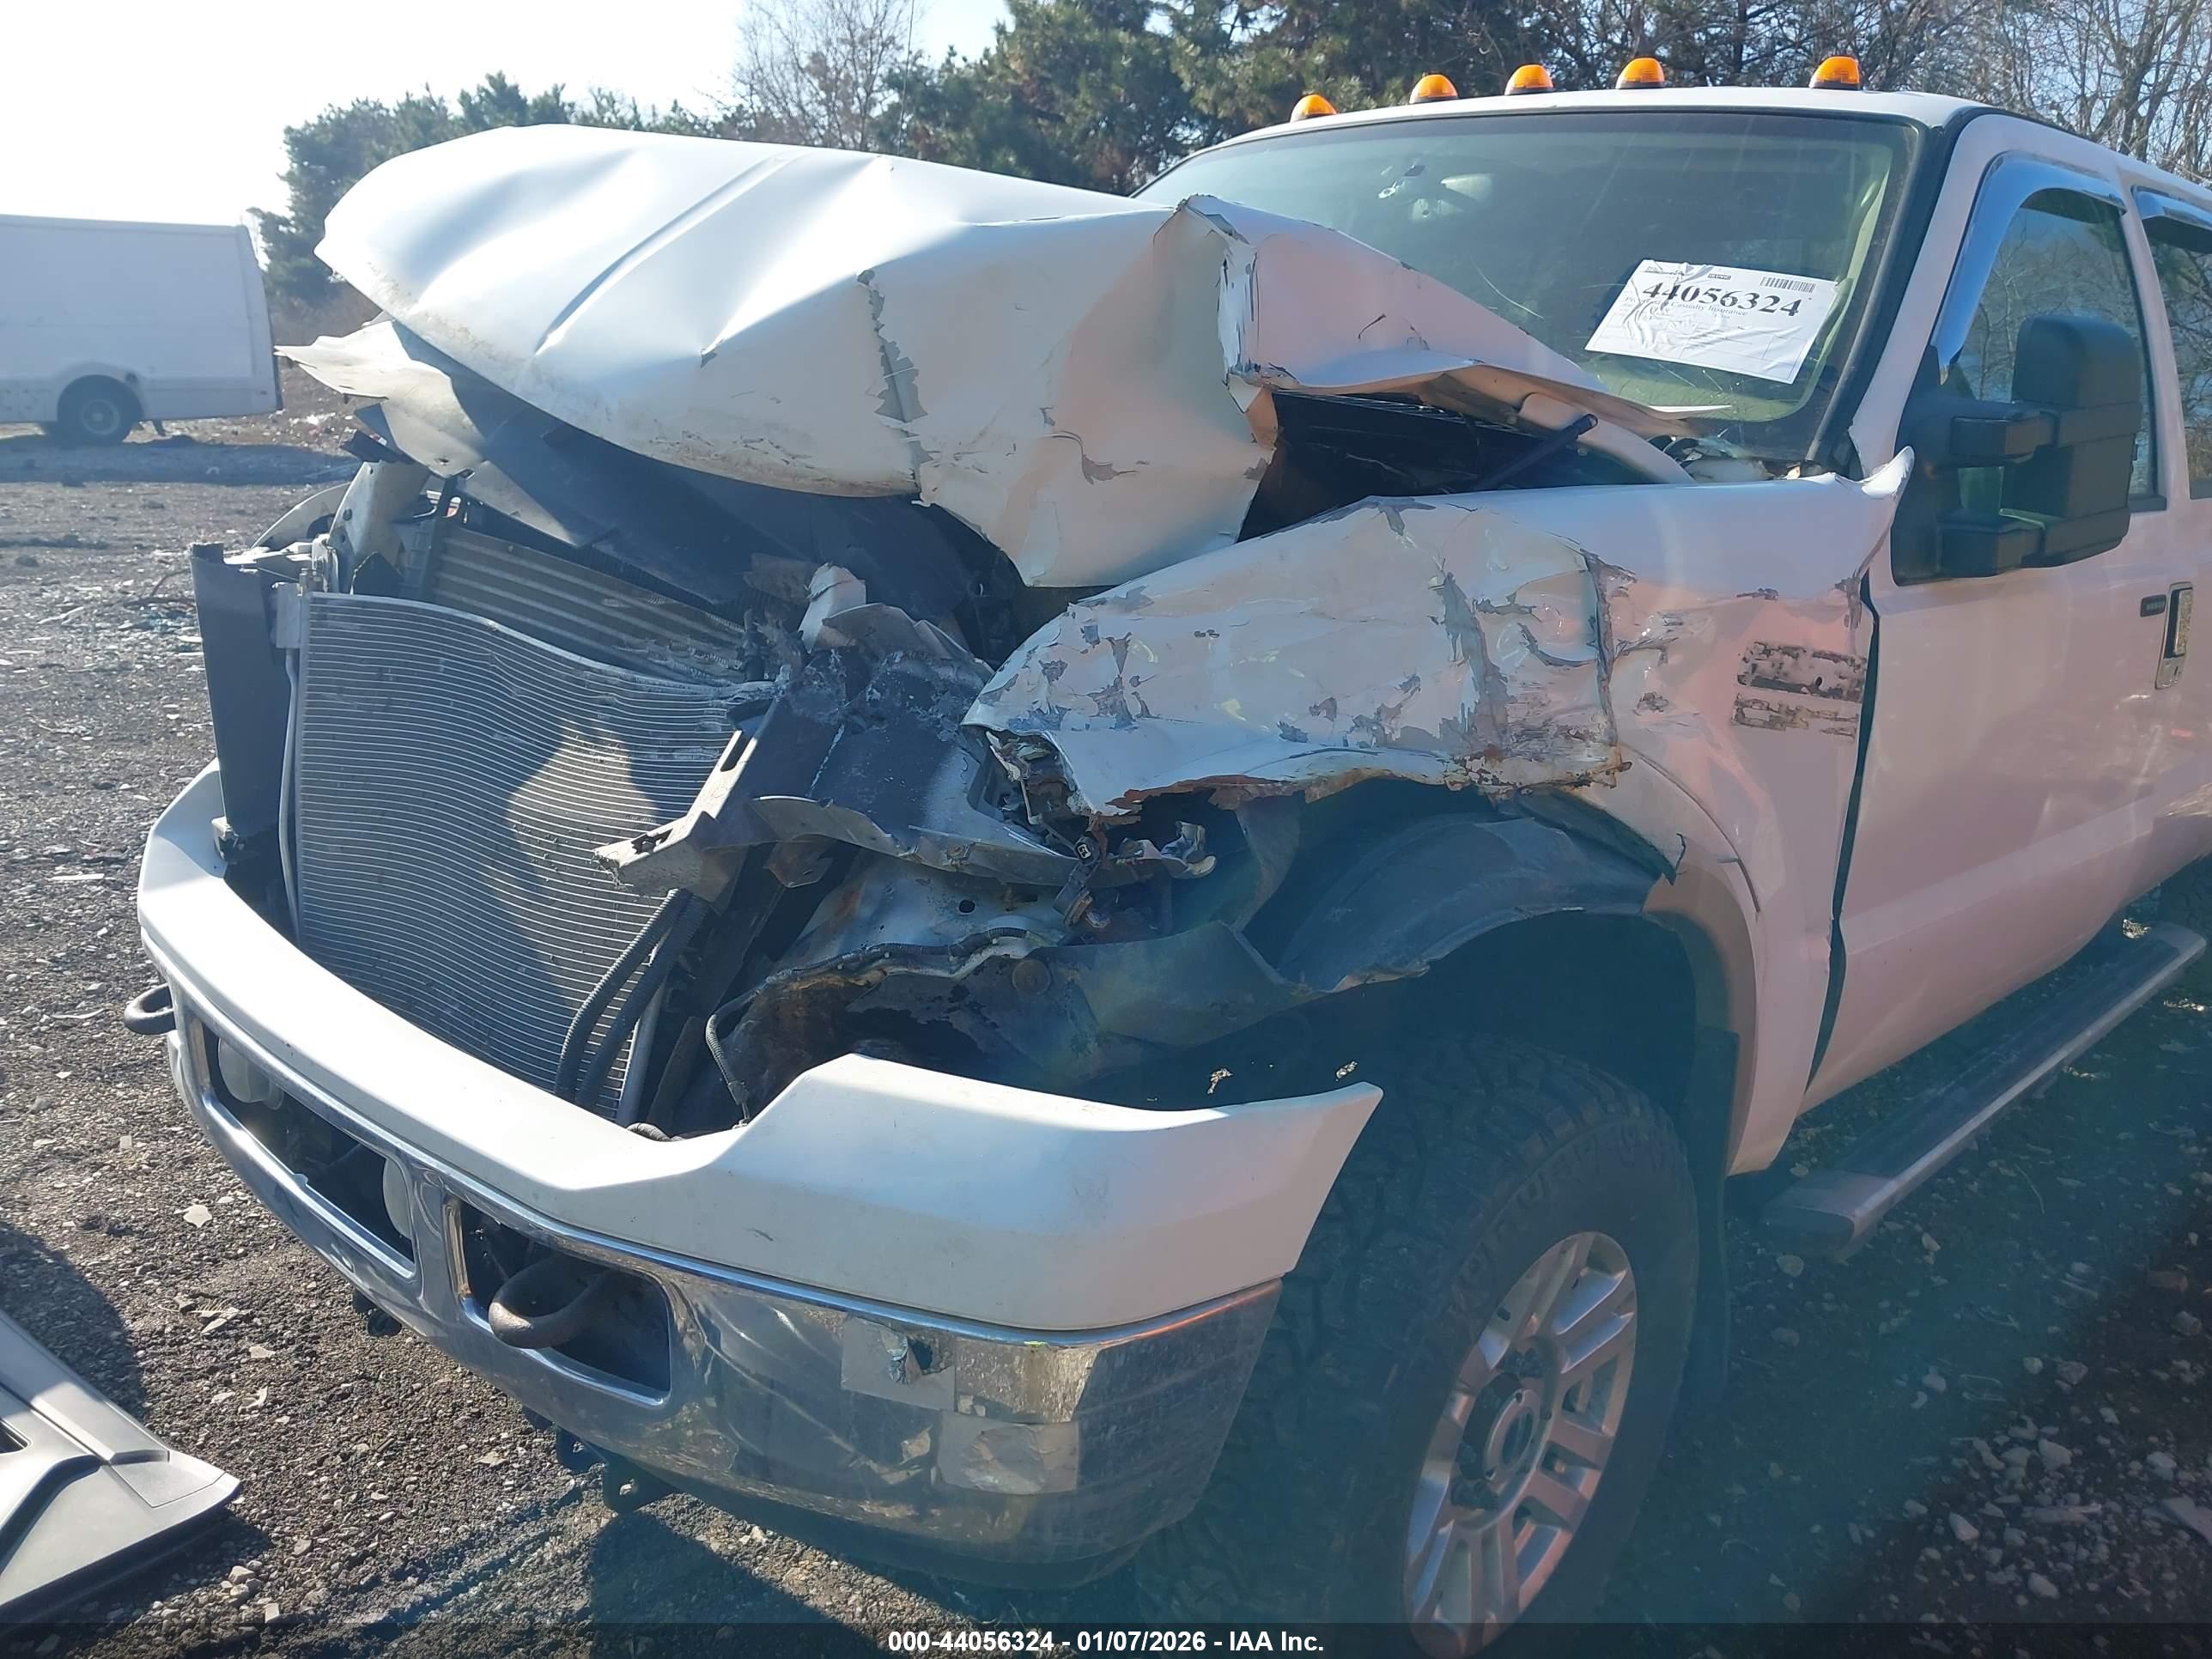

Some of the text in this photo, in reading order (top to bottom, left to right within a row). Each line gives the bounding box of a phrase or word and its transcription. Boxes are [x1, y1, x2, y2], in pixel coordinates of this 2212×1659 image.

[1642, 282, 1800, 316] 44056324
[1671, 301, 1705, 311] Casualty
[1708, 305, 1748, 316] Insurance
